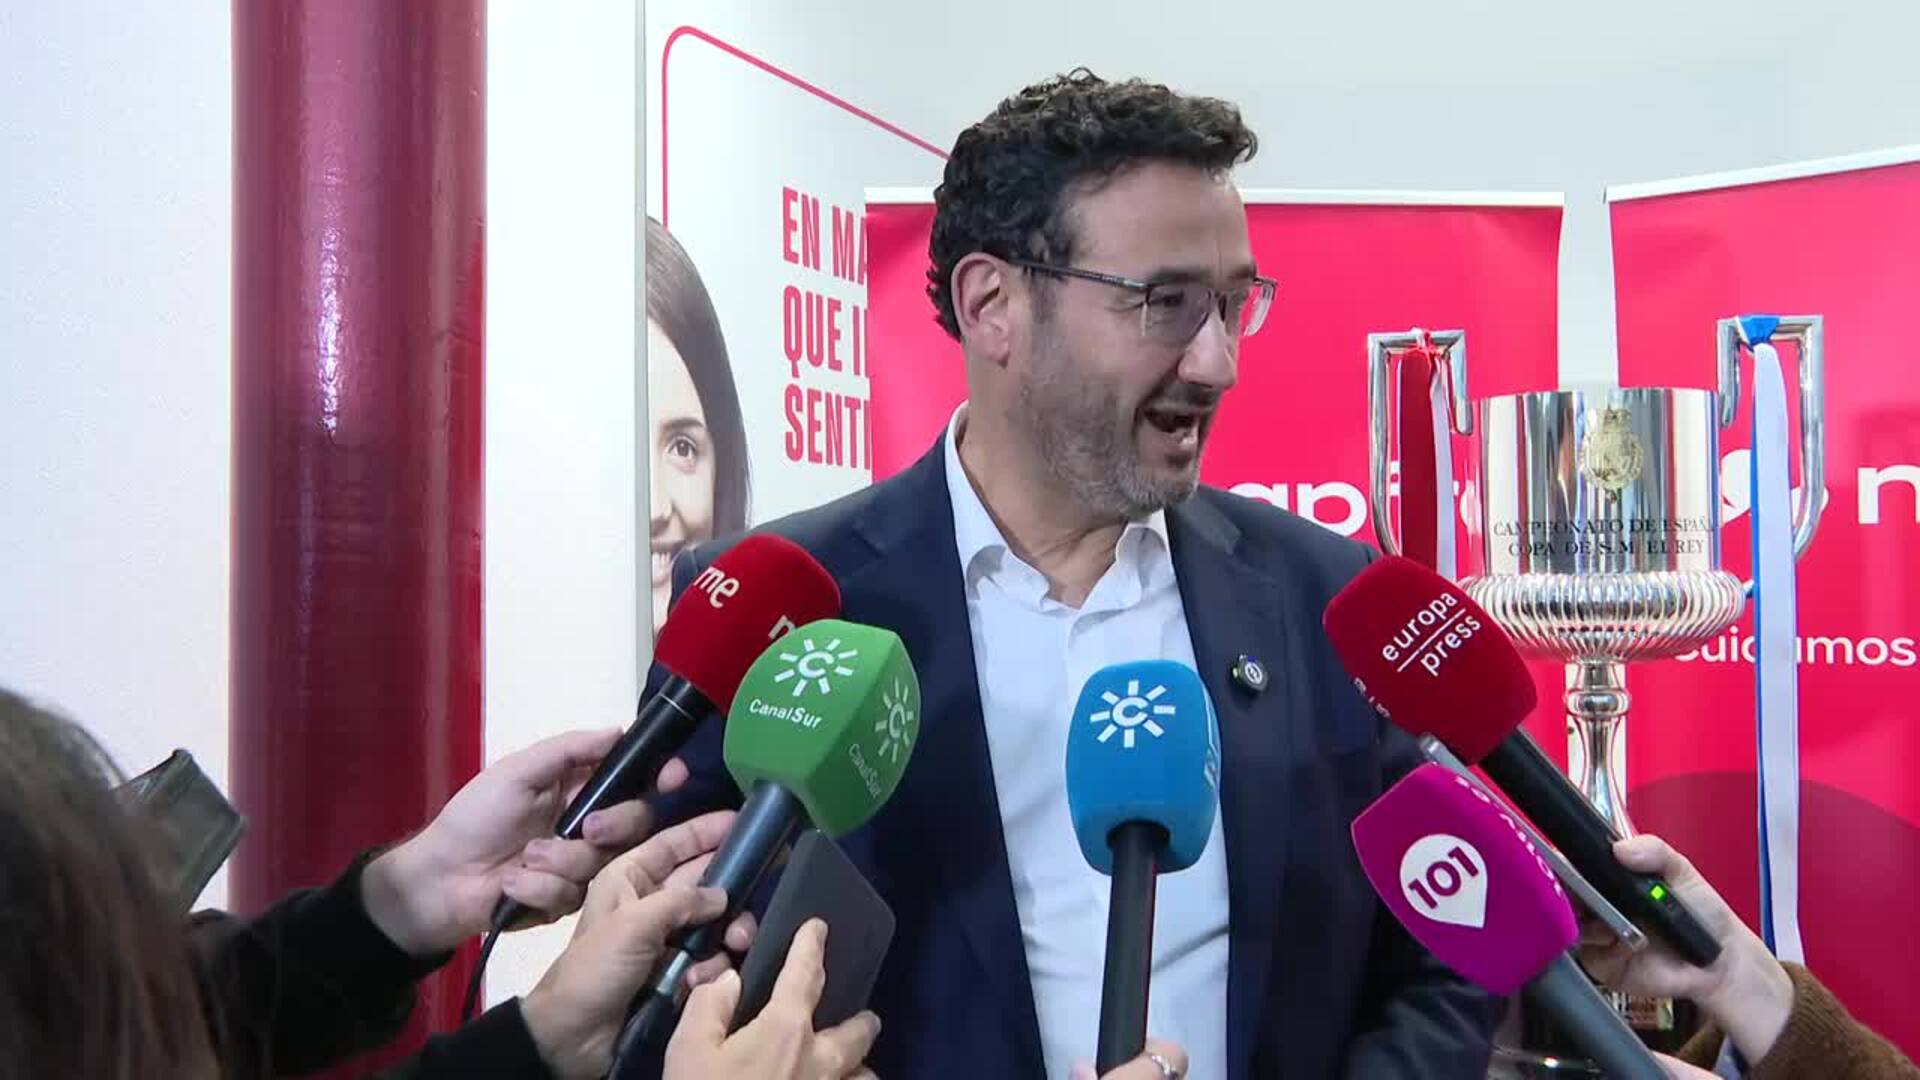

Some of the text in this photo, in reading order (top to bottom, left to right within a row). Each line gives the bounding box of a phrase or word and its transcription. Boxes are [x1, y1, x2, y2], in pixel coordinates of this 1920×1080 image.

[782, 186, 821, 272] EN
[783, 285, 843, 378] QUE
[1508, 541, 1555, 556] COPA
[1564, 540, 1592, 555] DE
[1675, 538, 1705, 554] REY
[1629, 518, 1657, 533] DE
[1381, 592, 1458, 662] europa
[1420, 614, 1482, 677] press
[749, 698, 822, 729] CanalSur
[1407, 845, 1480, 910] 101
